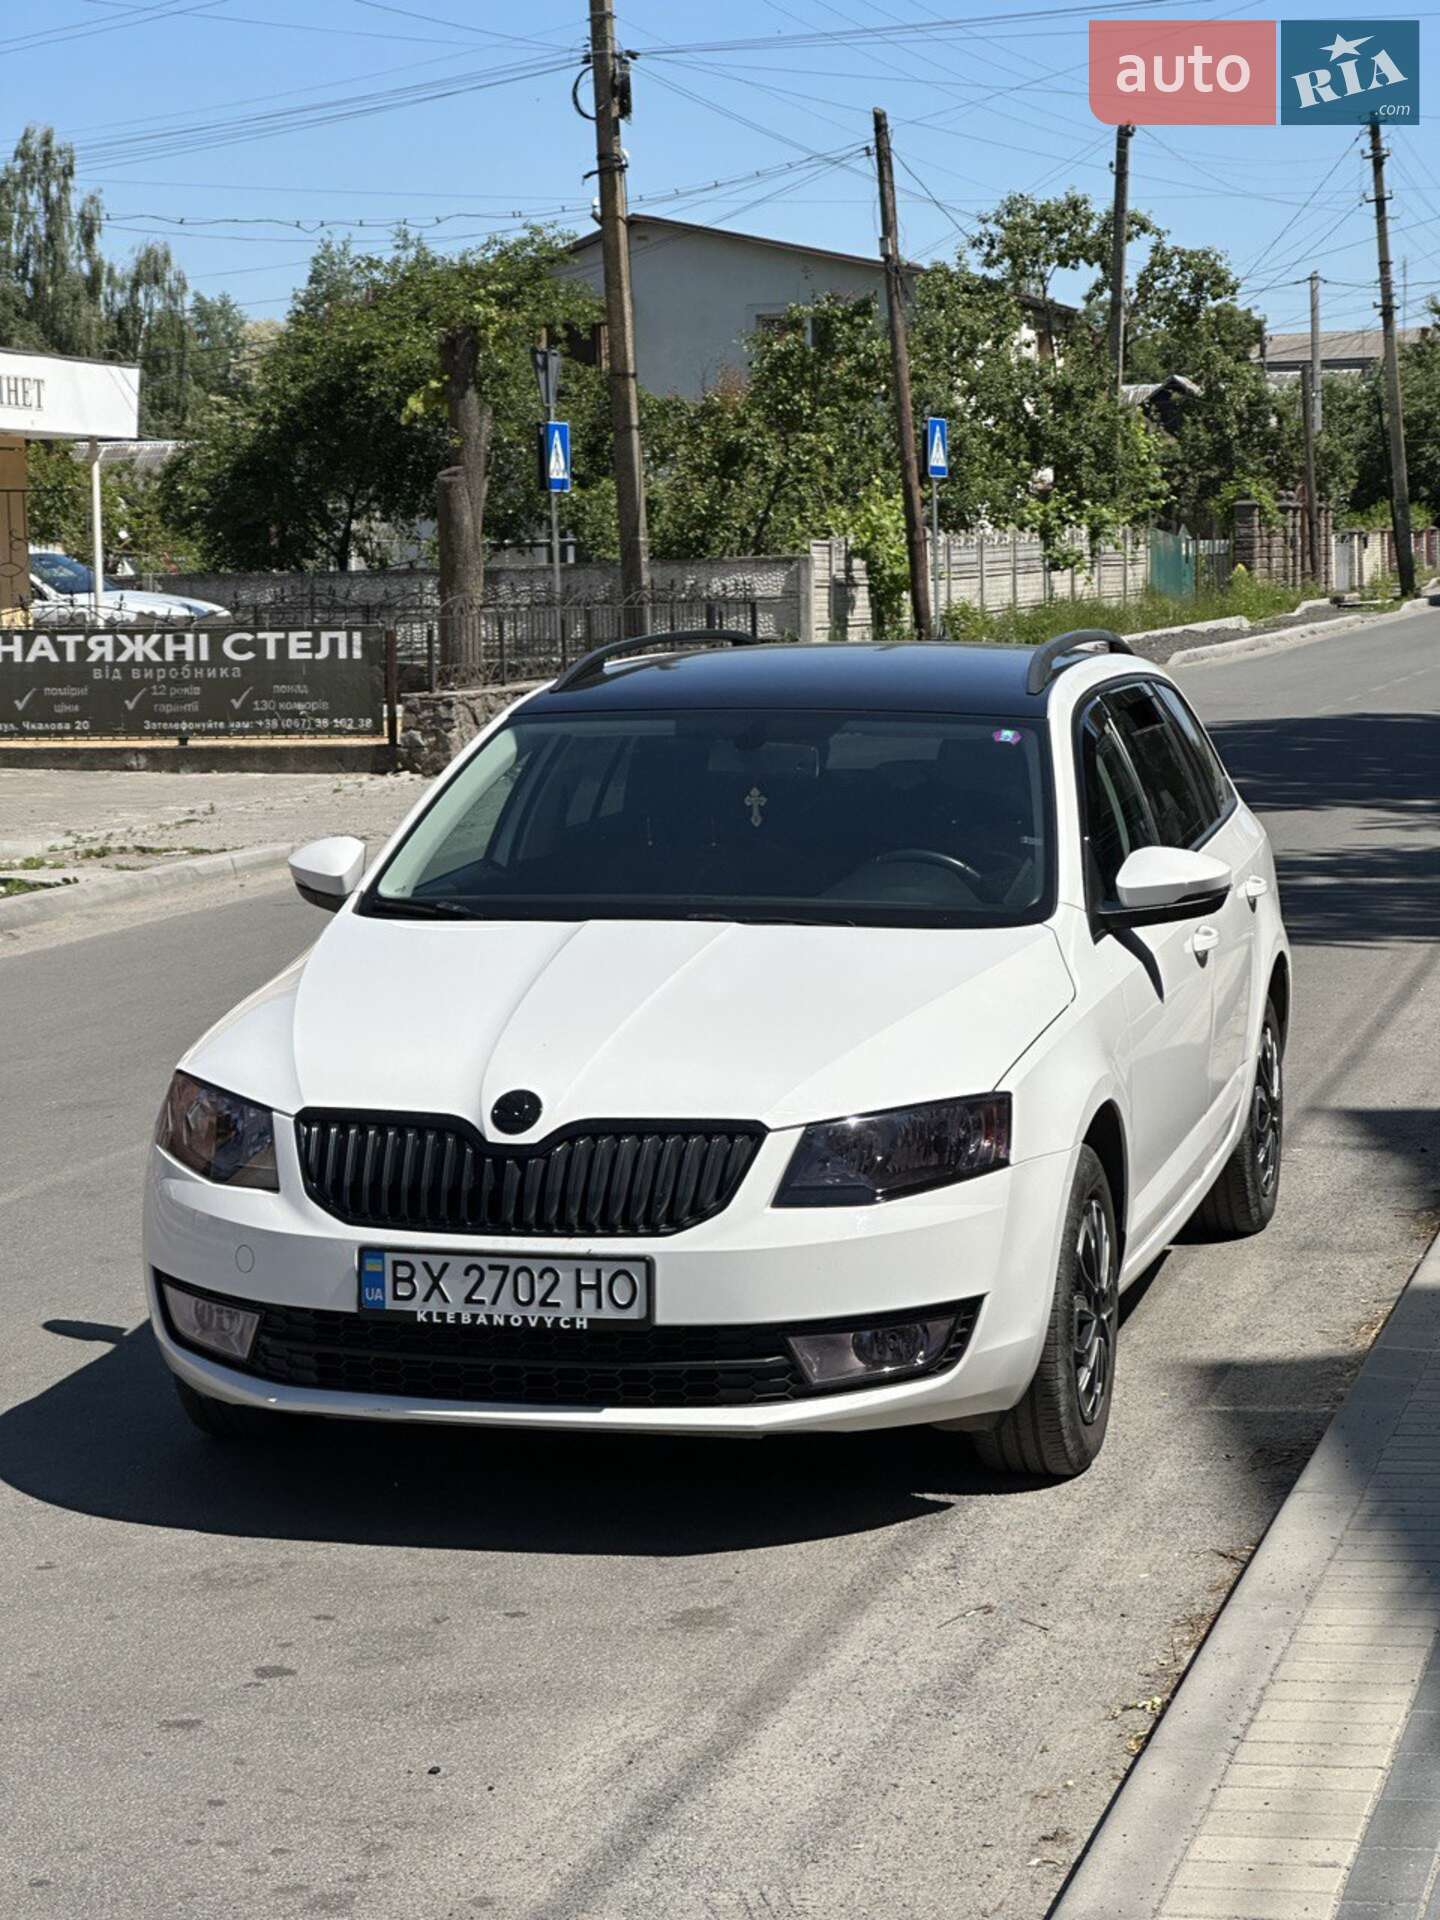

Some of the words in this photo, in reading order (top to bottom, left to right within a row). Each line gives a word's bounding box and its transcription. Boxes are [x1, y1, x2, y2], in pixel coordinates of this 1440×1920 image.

[0, 632, 209, 662] НАТЯЖНІ
[222, 631, 363, 660] СТЕЛІ
[92, 664, 122, 680] від
[131, 664, 242, 681] виробника
[151, 685, 167, 696] 12
[169, 685, 201, 697] років
[252, 699, 276, 711] 130
[22, 720, 71, 731] Чкалова
[74, 720, 90, 730] 20
[143, 719, 226, 732] Зателефонуйте
[391, 1259, 451, 1303] BX
[464, 1263, 562, 1309] 2702
[576, 1267, 639, 1311] HO
[365, 1287, 384, 1301] UA
[415, 1309, 589, 1330] KLEBANOVYCH
